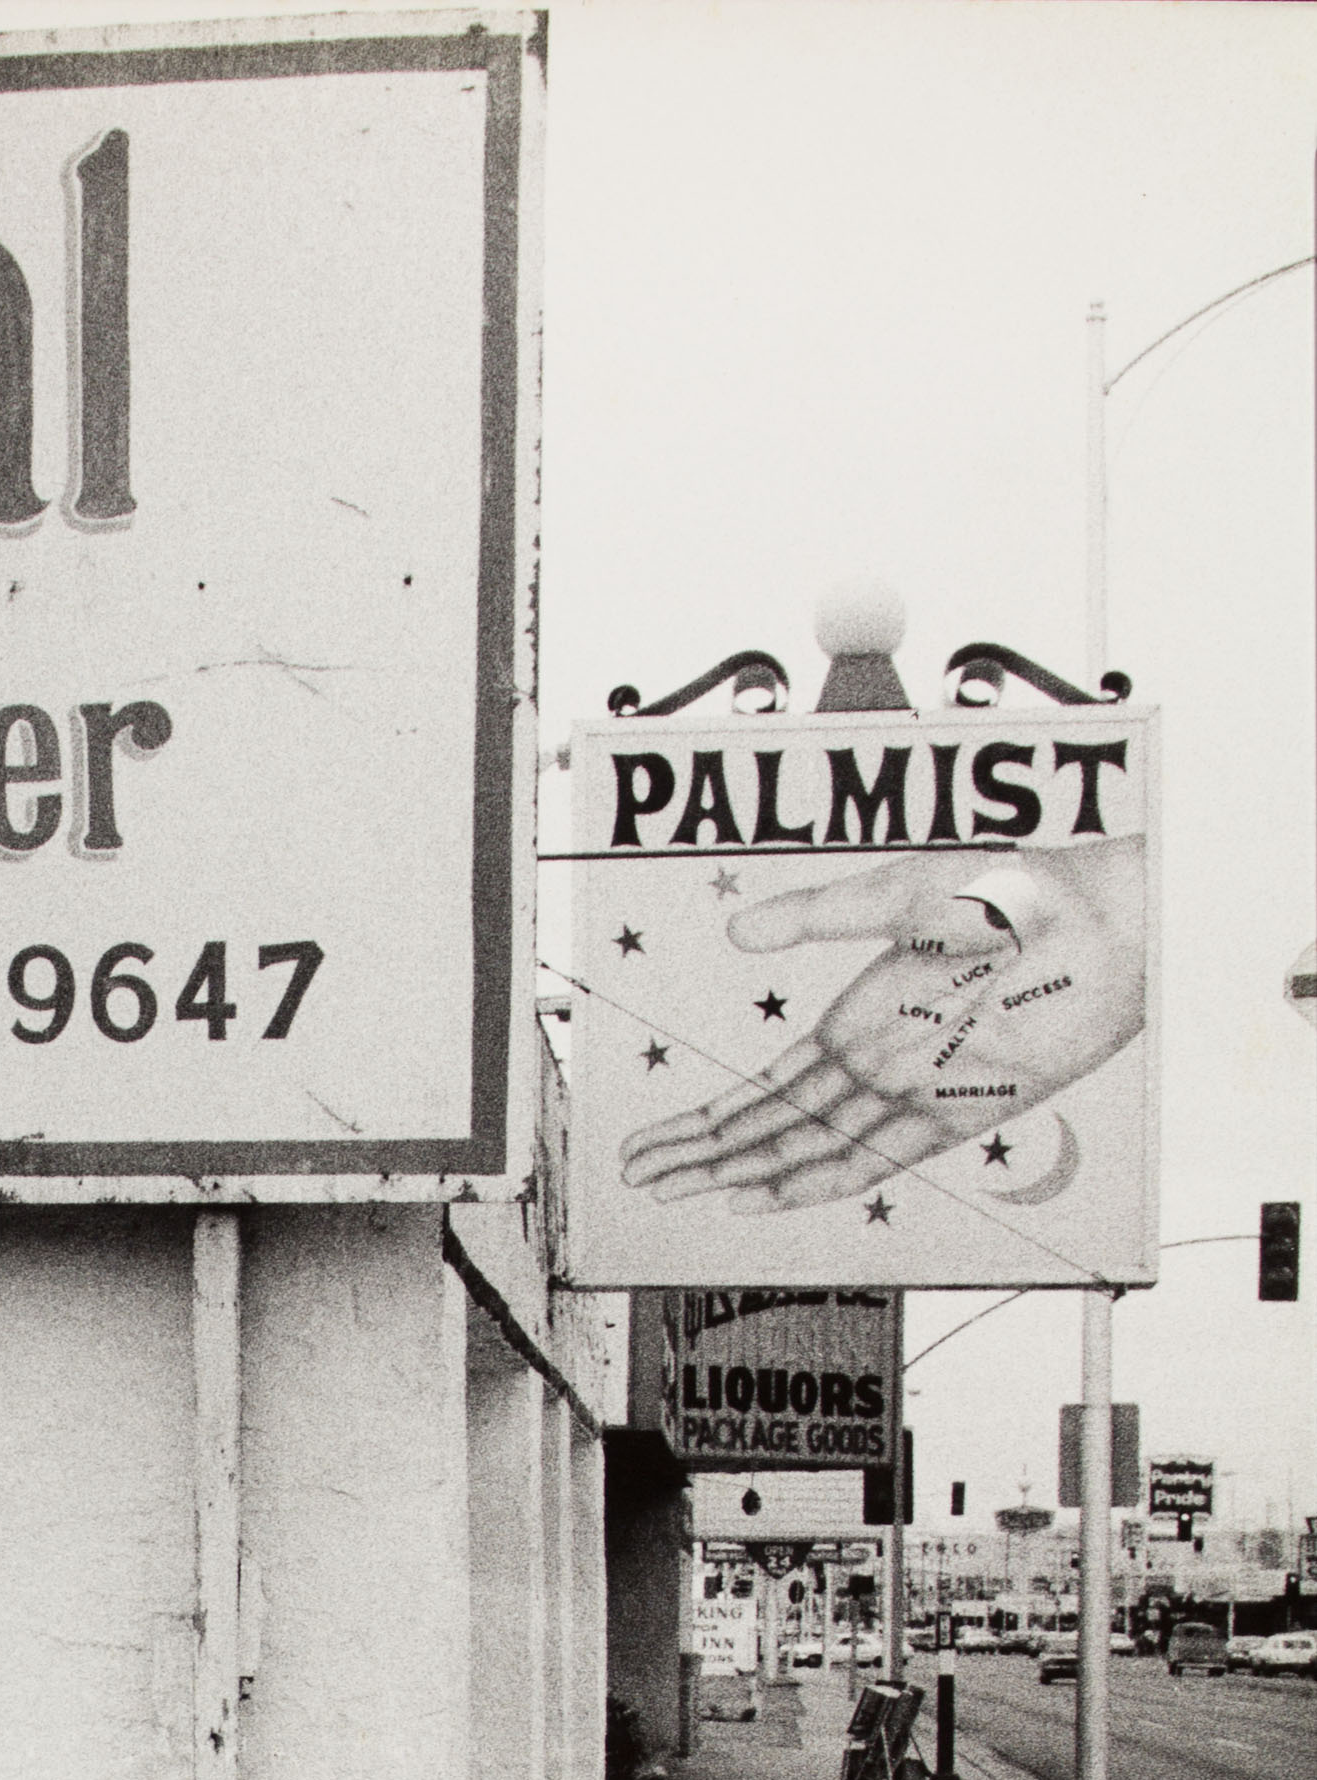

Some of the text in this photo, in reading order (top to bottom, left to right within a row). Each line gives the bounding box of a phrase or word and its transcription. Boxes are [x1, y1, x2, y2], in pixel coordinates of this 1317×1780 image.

[611, 739, 1129, 848] PALMIST
[911, 938, 945, 953] LIFE
[952, 962, 994, 988] LUCK
[1001, 975, 1073, 1010] SUCCESS
[898, 1003, 943, 1025] LOVE
[933, 1015, 978, 1070] HEALTH
[934, 1083, 1018, 1099] MARRIAGE
[681, 1364, 883, 1419] LIQUORS
[682, 1415, 884, 1456] PACKAGE GOODS
[1154, 1489, 1208, 1507] Pride
[767, 1556, 792, 1569] 24
[701, 1636, 734, 1649] INN
